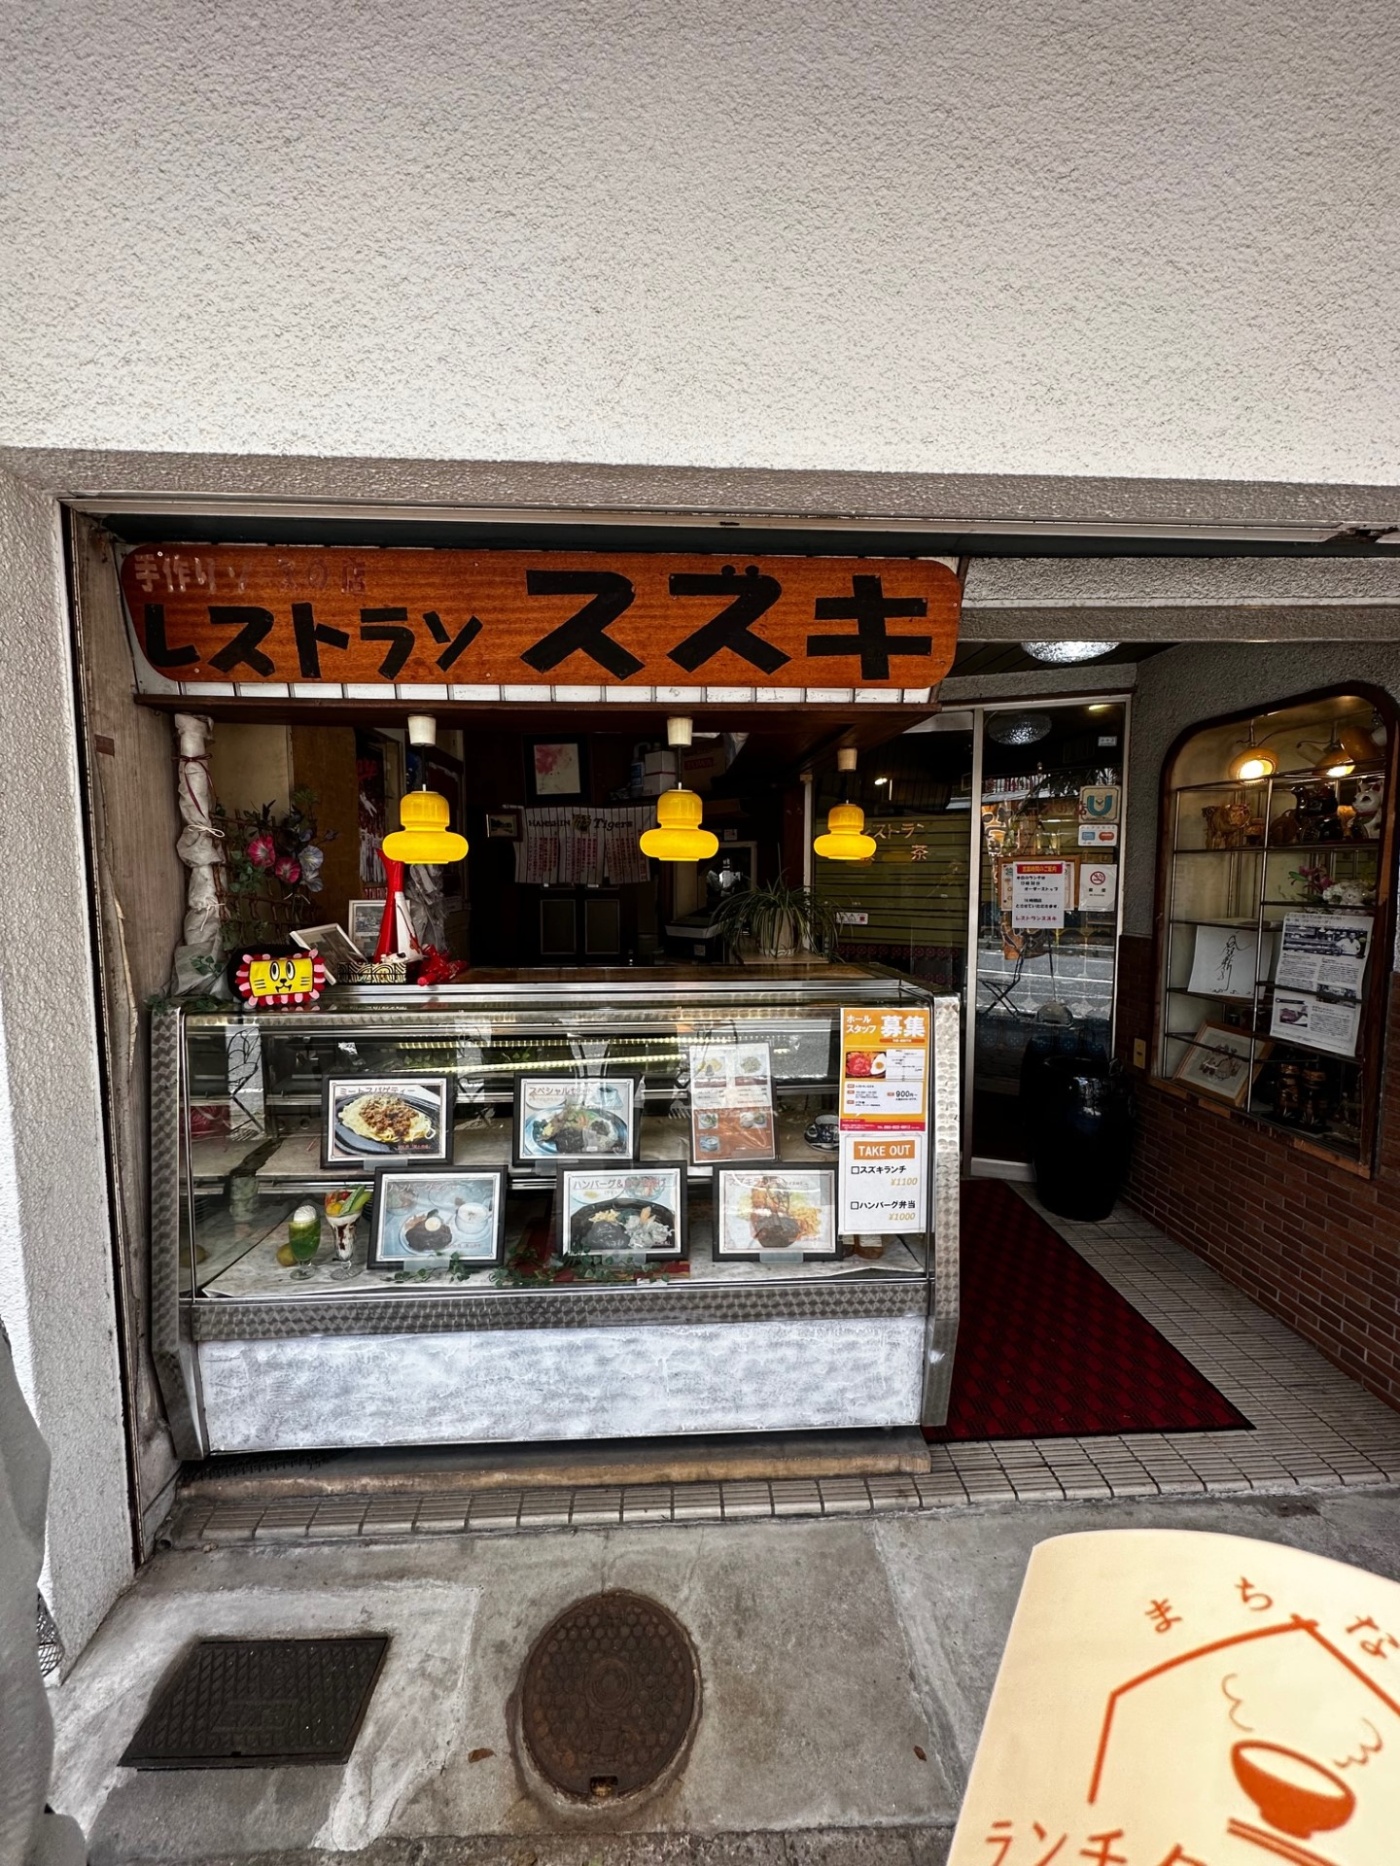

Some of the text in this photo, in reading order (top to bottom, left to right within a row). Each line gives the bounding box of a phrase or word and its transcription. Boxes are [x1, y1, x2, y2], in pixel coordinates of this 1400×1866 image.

[143, 565, 933, 681] レストラン スズキ
[528, 818, 633, 831] HANSHIN Tigers
[846, 1014, 872, 1024] ホール
[846, 1024, 877, 1034] スタッフ
[880, 1015, 926, 1038] 募集
[858, 1144, 911, 1157] TAKE OUT
[859, 1165, 907, 1174] スズキランチ
[890, 1177, 918, 1186] ¥1100
[859, 1200, 916, 1209] ハンバーグ弁当
[889, 1212, 916, 1221] ¥1000
